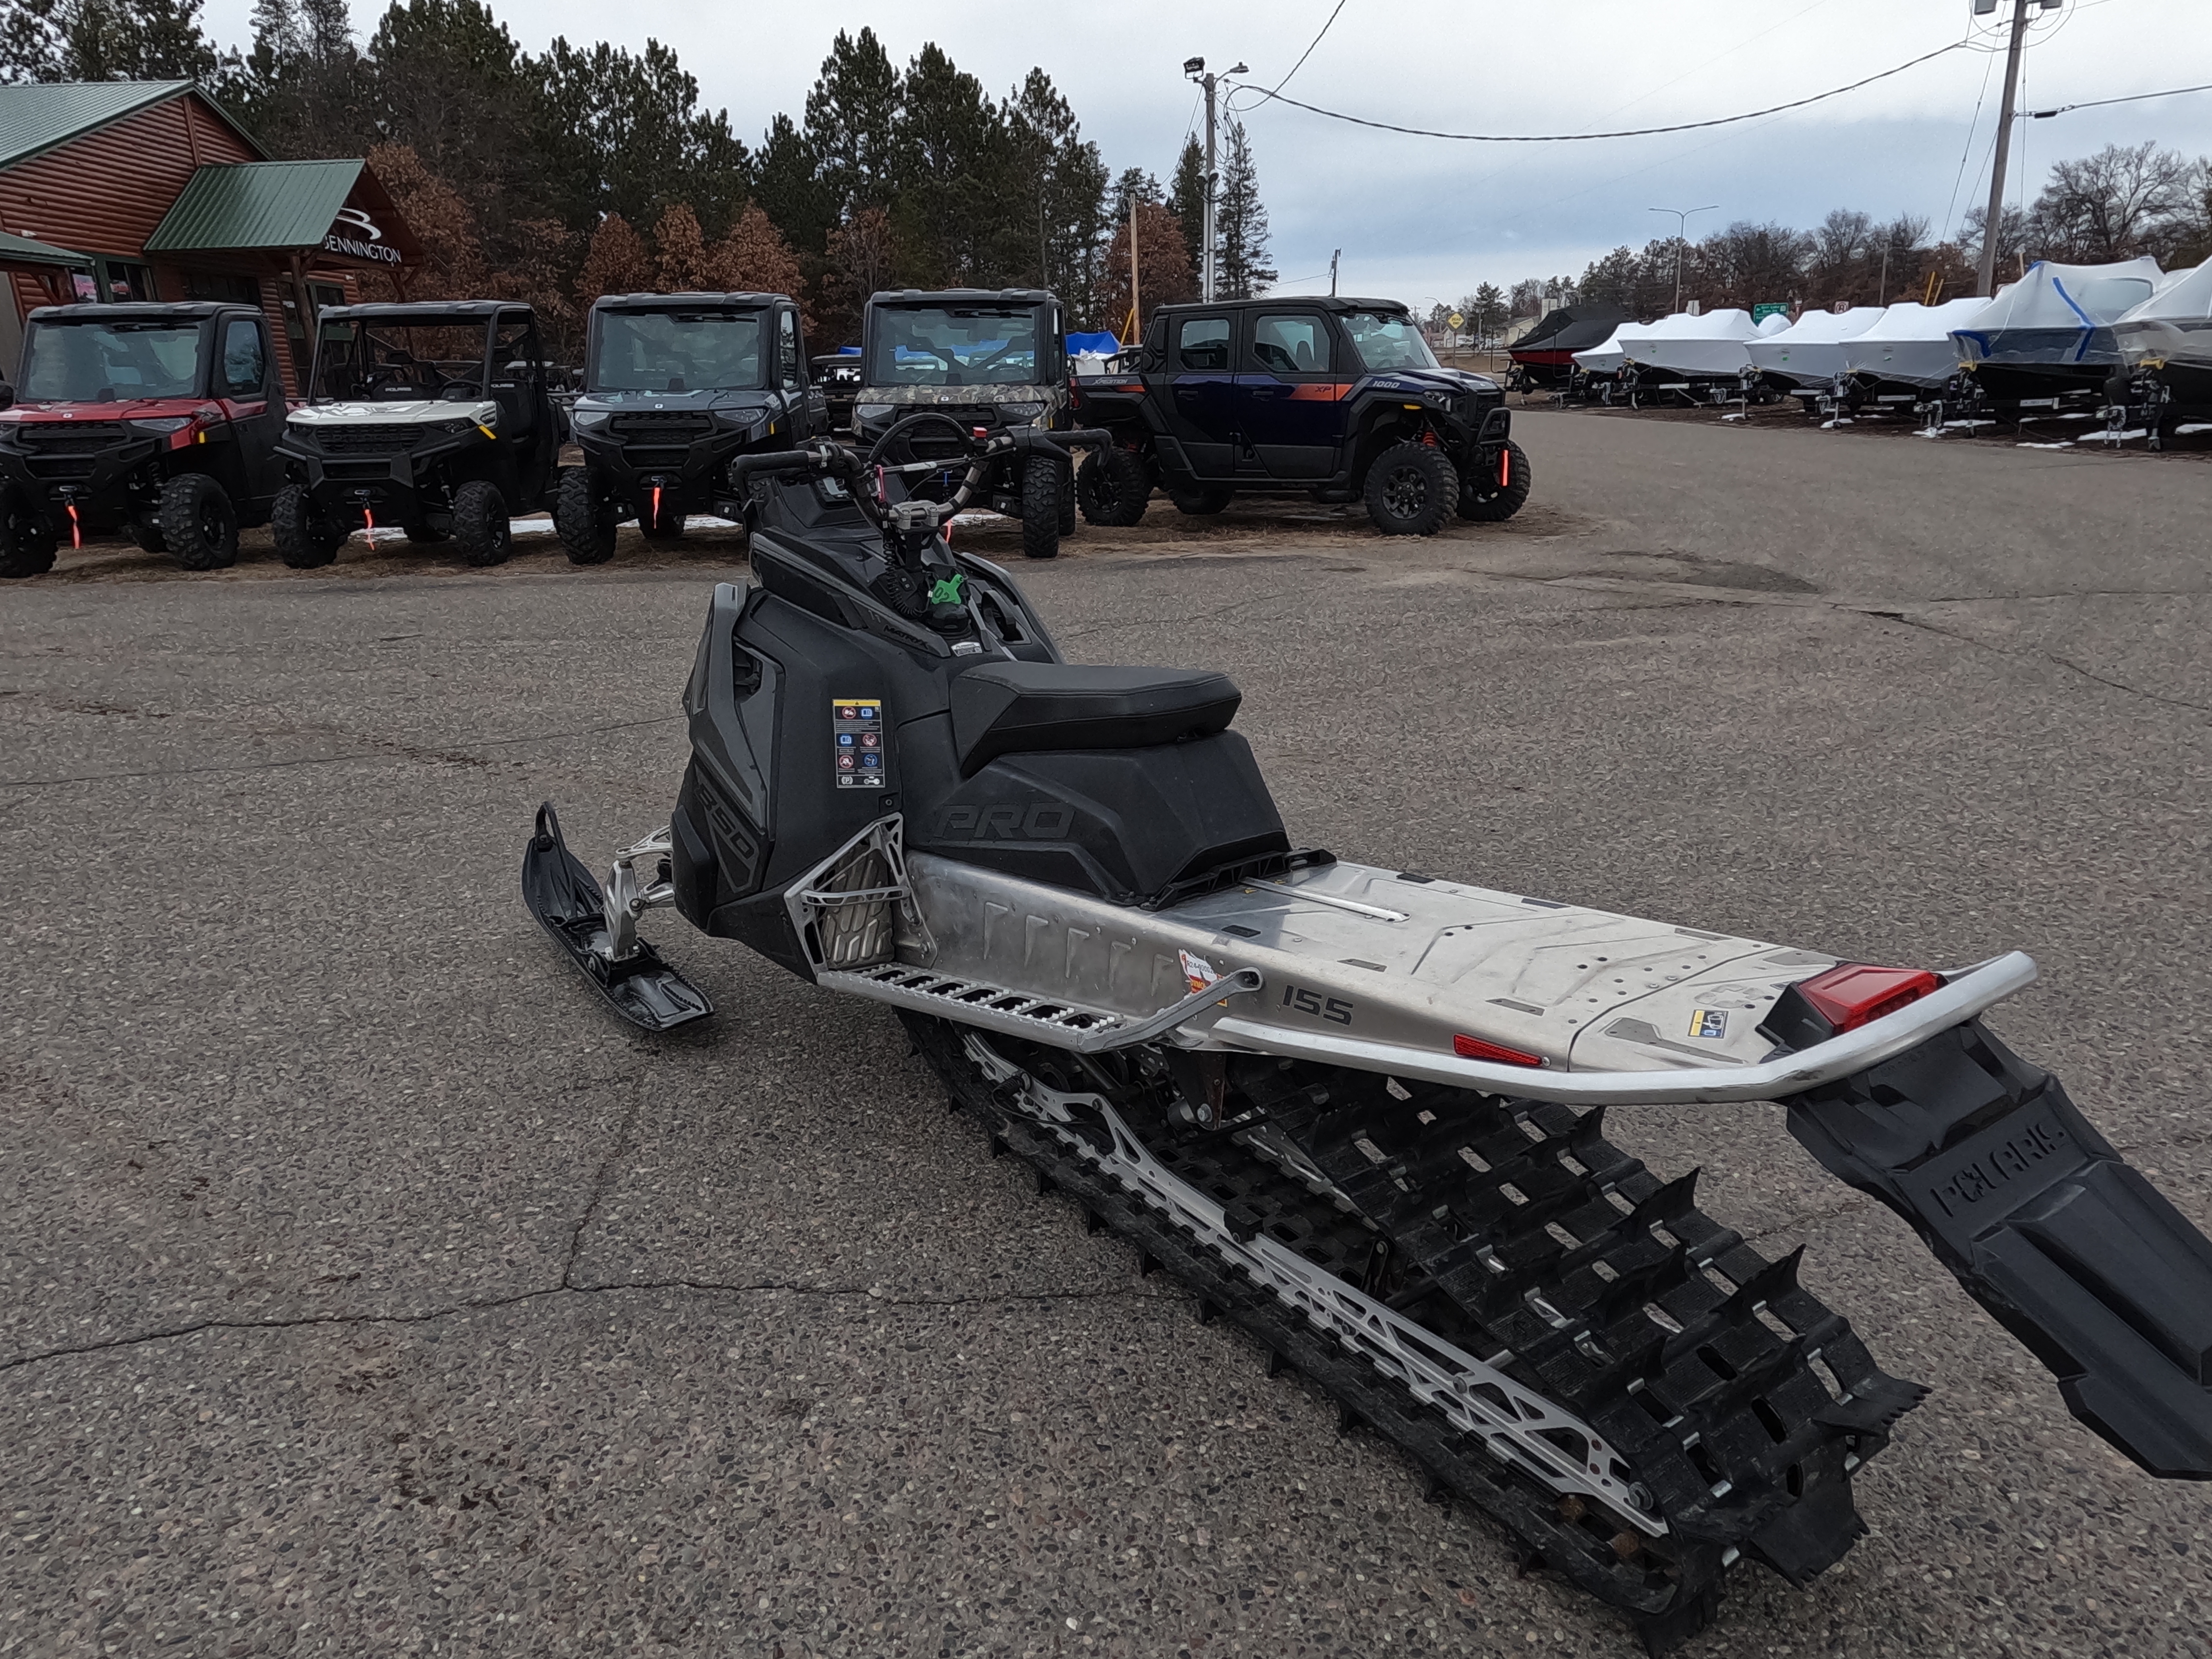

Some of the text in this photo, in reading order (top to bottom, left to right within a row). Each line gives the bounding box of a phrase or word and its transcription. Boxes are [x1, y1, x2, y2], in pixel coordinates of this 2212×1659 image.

[698, 783, 754, 859] 850
[933, 801, 1076, 838] PRO
[1283, 985, 1353, 1025] 155
